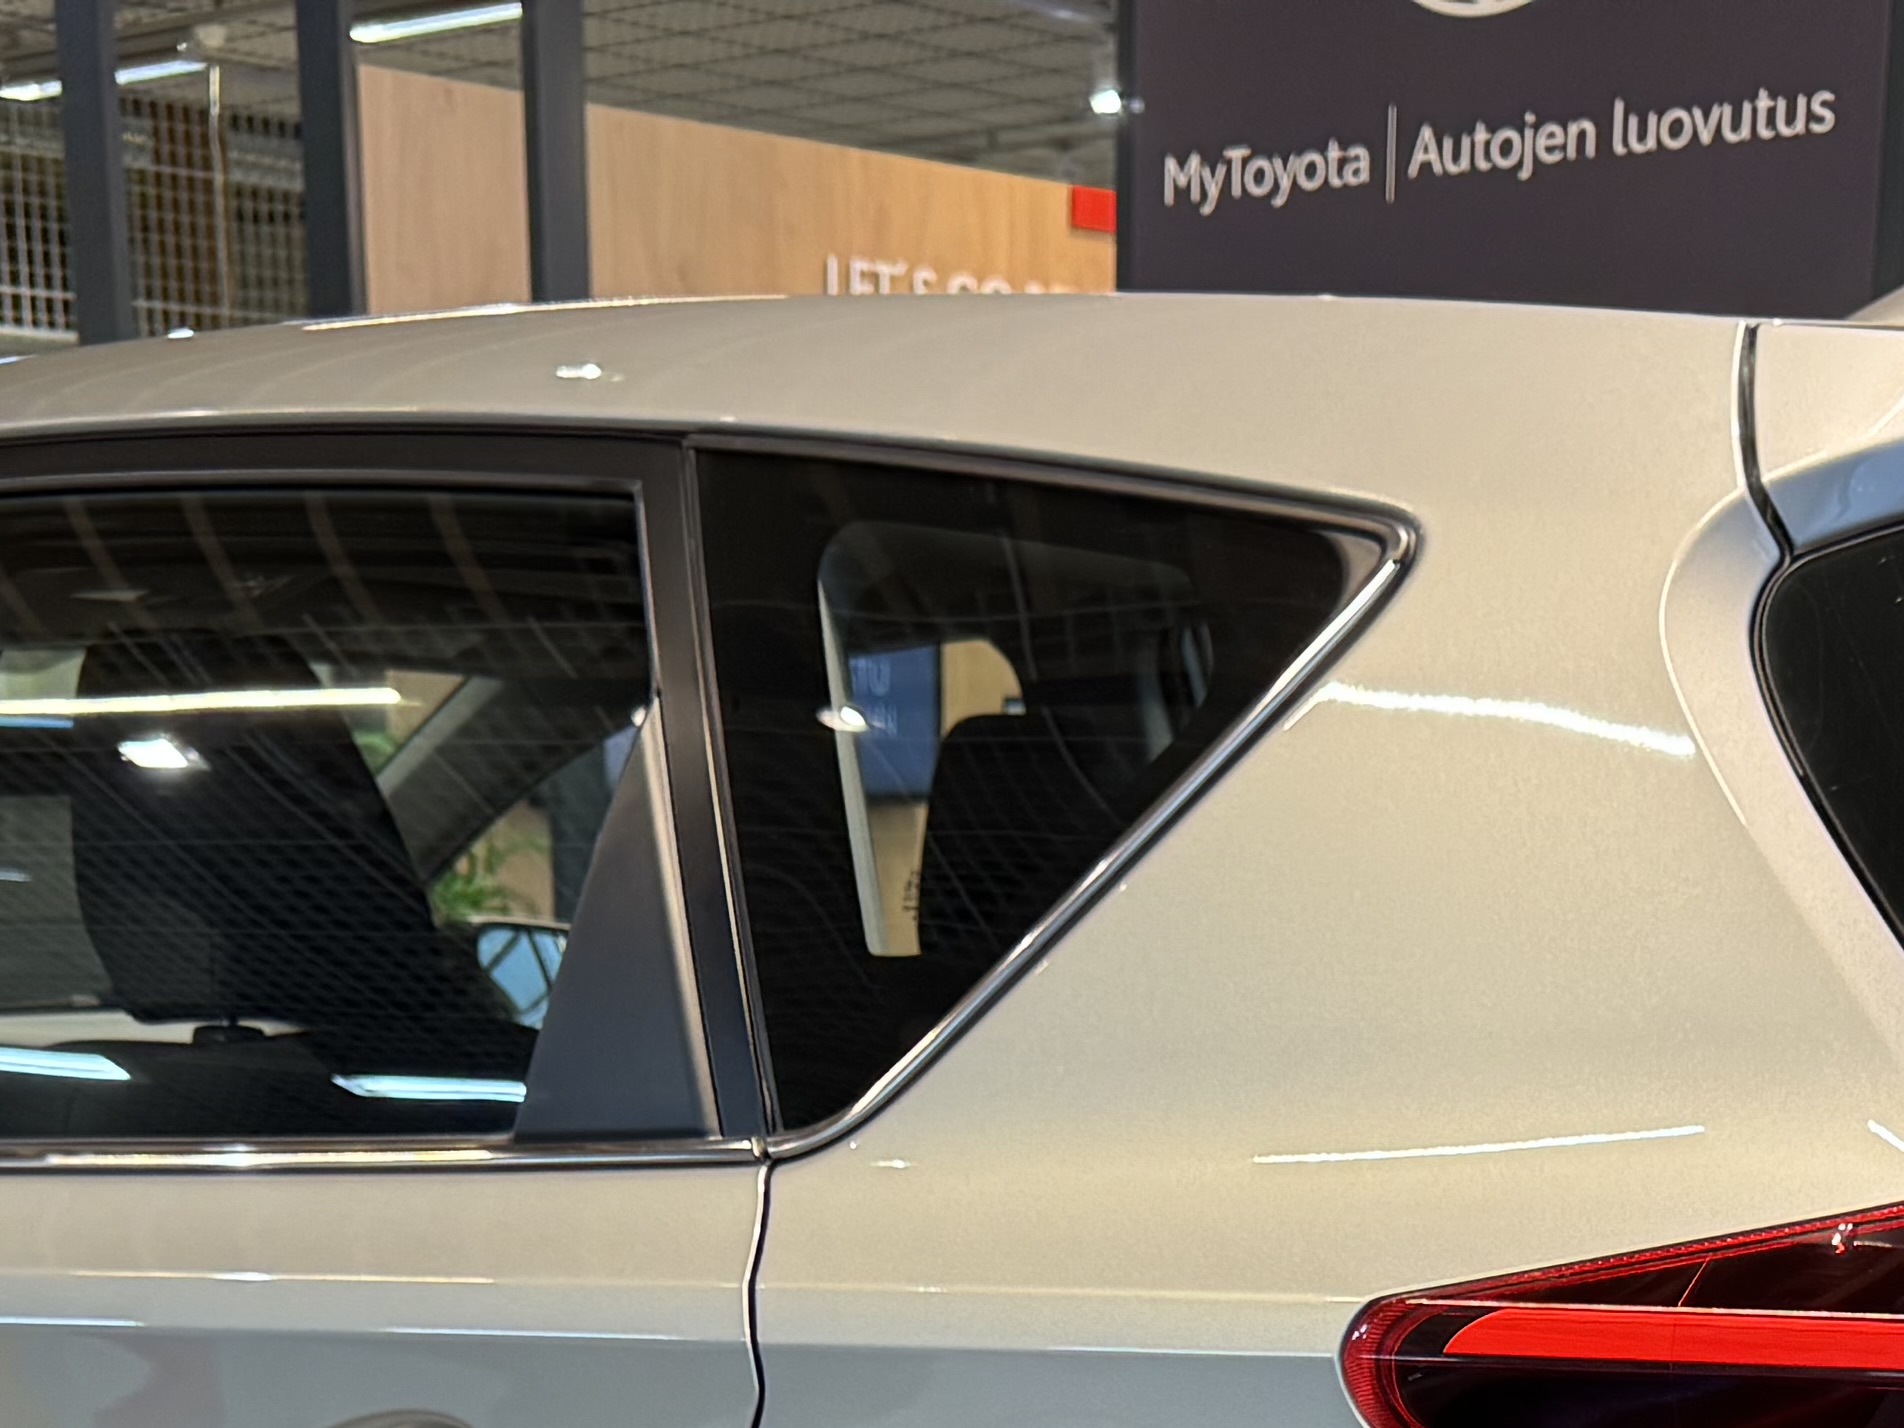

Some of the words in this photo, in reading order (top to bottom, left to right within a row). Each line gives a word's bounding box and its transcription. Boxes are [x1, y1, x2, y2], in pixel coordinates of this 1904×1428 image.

[1163, 138, 1371, 216] MyToyota
[1407, 109, 1597, 181] Autojen
[1612, 86, 1837, 158] luovutus
